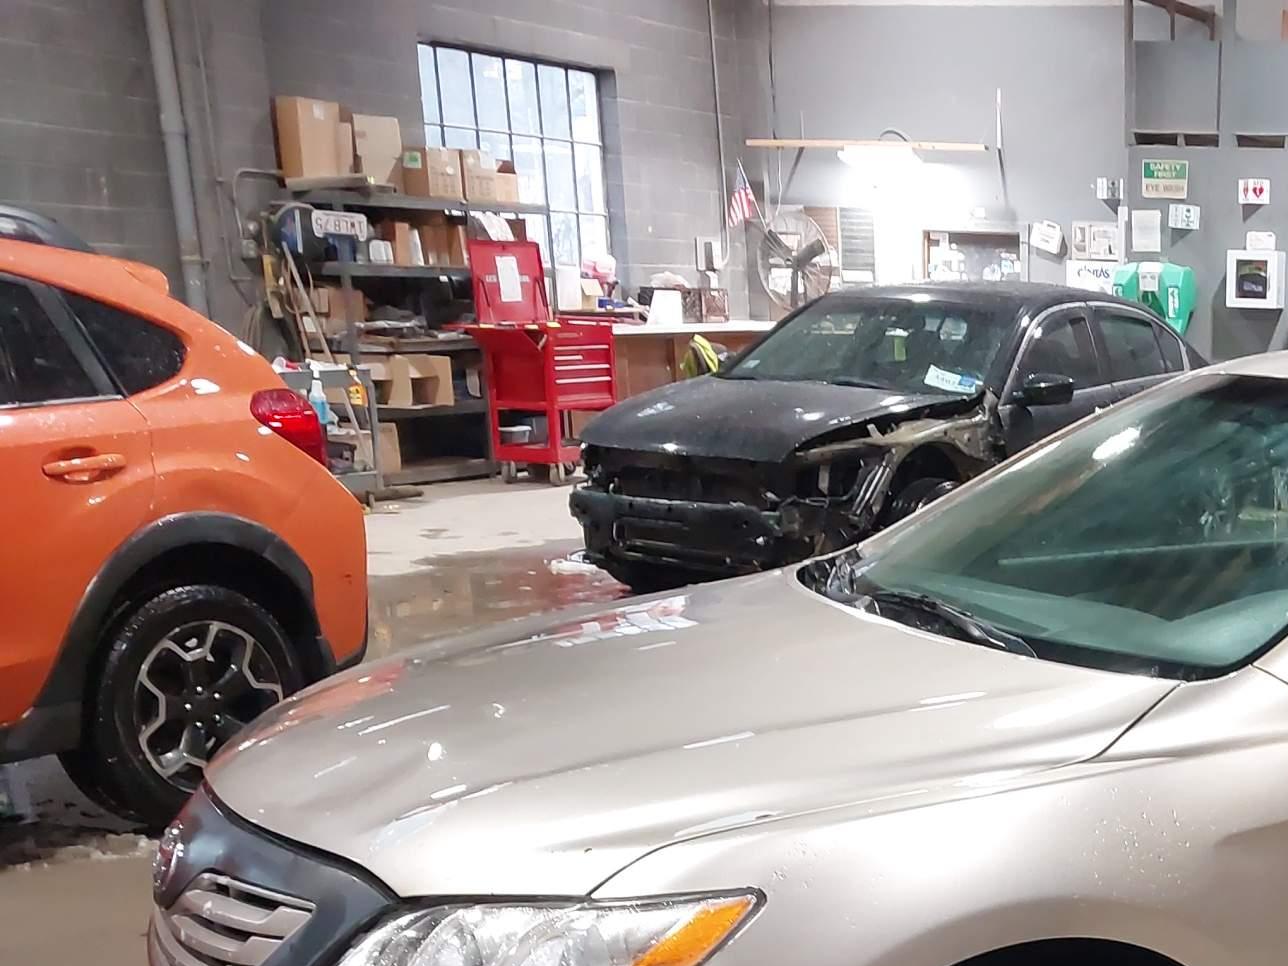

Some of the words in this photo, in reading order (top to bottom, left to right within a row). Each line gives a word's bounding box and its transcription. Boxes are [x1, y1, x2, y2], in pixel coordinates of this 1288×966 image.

[1149, 162, 1180, 171] SAFETY
[1153, 171, 1176, 179] FIRST
[1145, 183, 1159, 192] EYE
